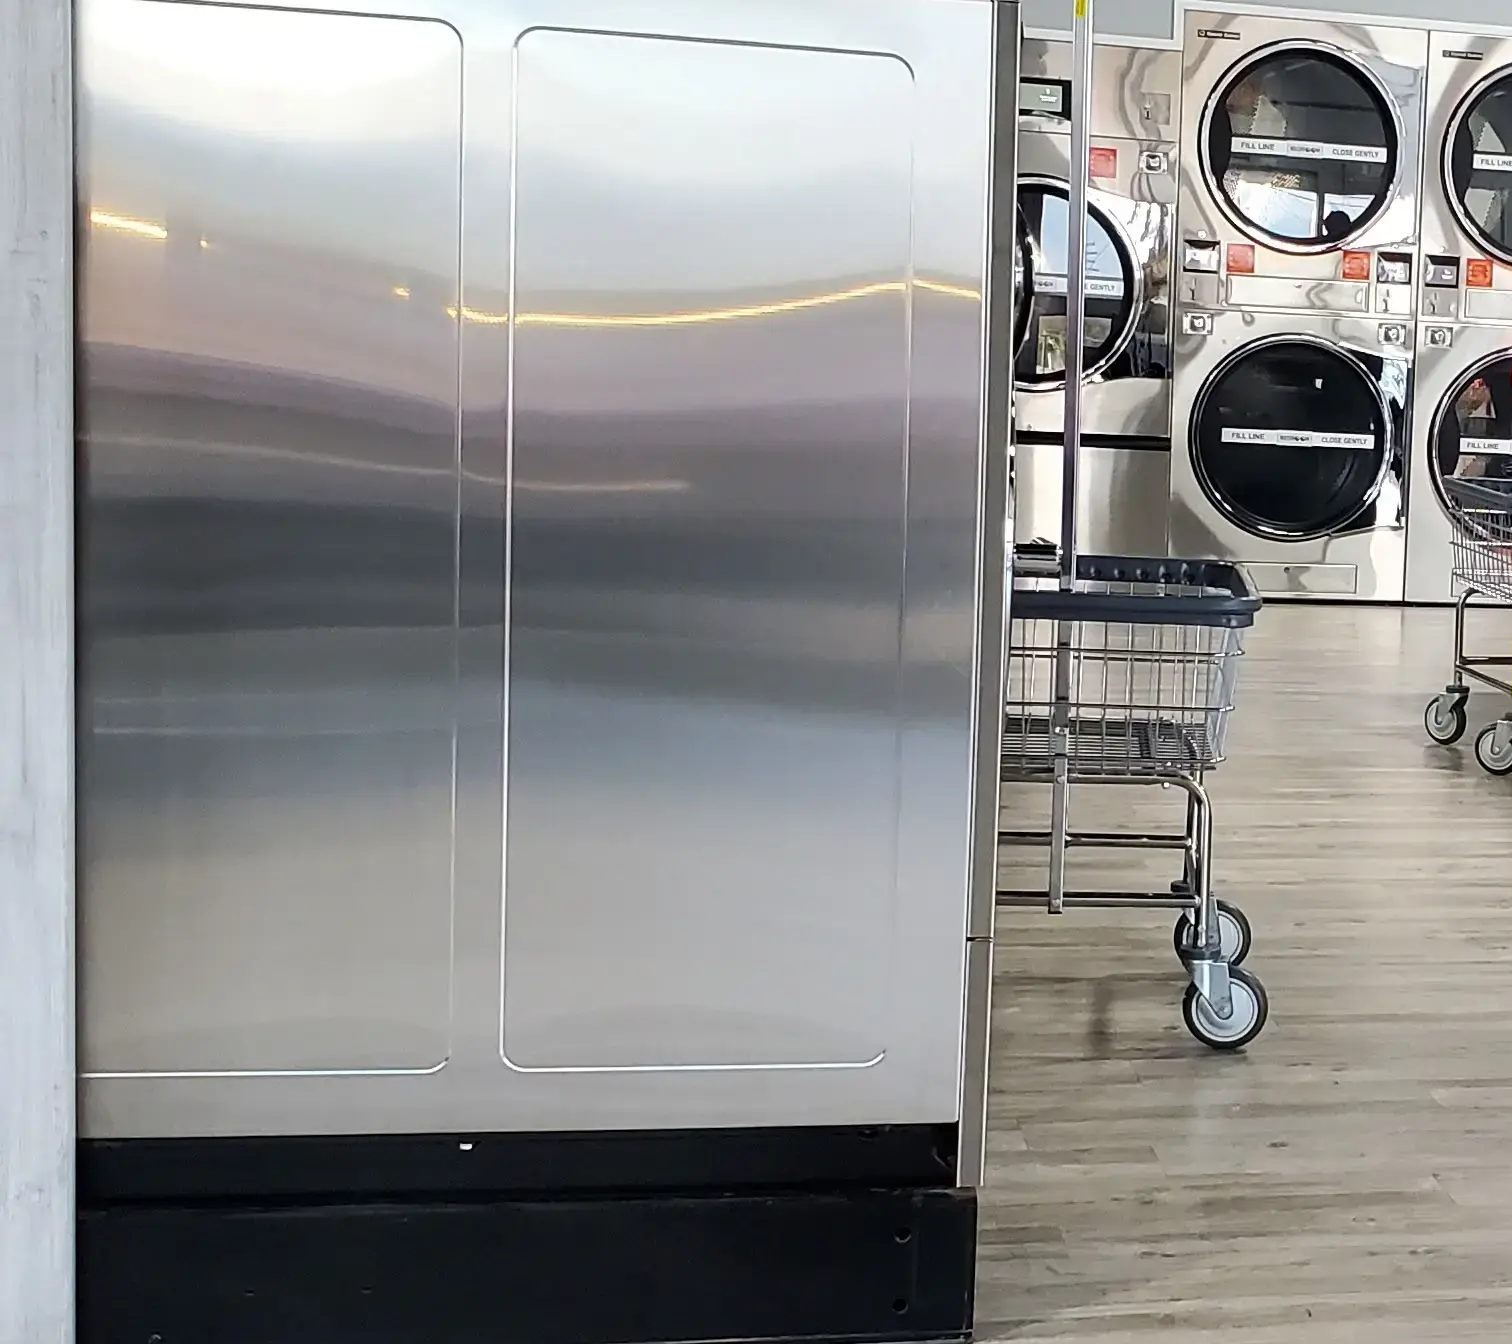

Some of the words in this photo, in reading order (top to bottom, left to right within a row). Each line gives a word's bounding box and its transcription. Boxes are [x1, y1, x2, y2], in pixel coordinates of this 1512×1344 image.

[1240, 141, 1256, 150] FILL
[1258, 142, 1275, 151] LINE
[1332, 148, 1353, 157] CLOSE
[1355, 149, 1379, 158] GENTLY
[1480, 158, 1495, 166] FILL
[1497, 159, 1512, 167] LINE
[1231, 432, 1246, 440] FILL
[1248, 432, 1265, 441] LINE
[1321, 436, 1342, 444] CLOSE
[1343, 437, 1368, 445] GENTLY
